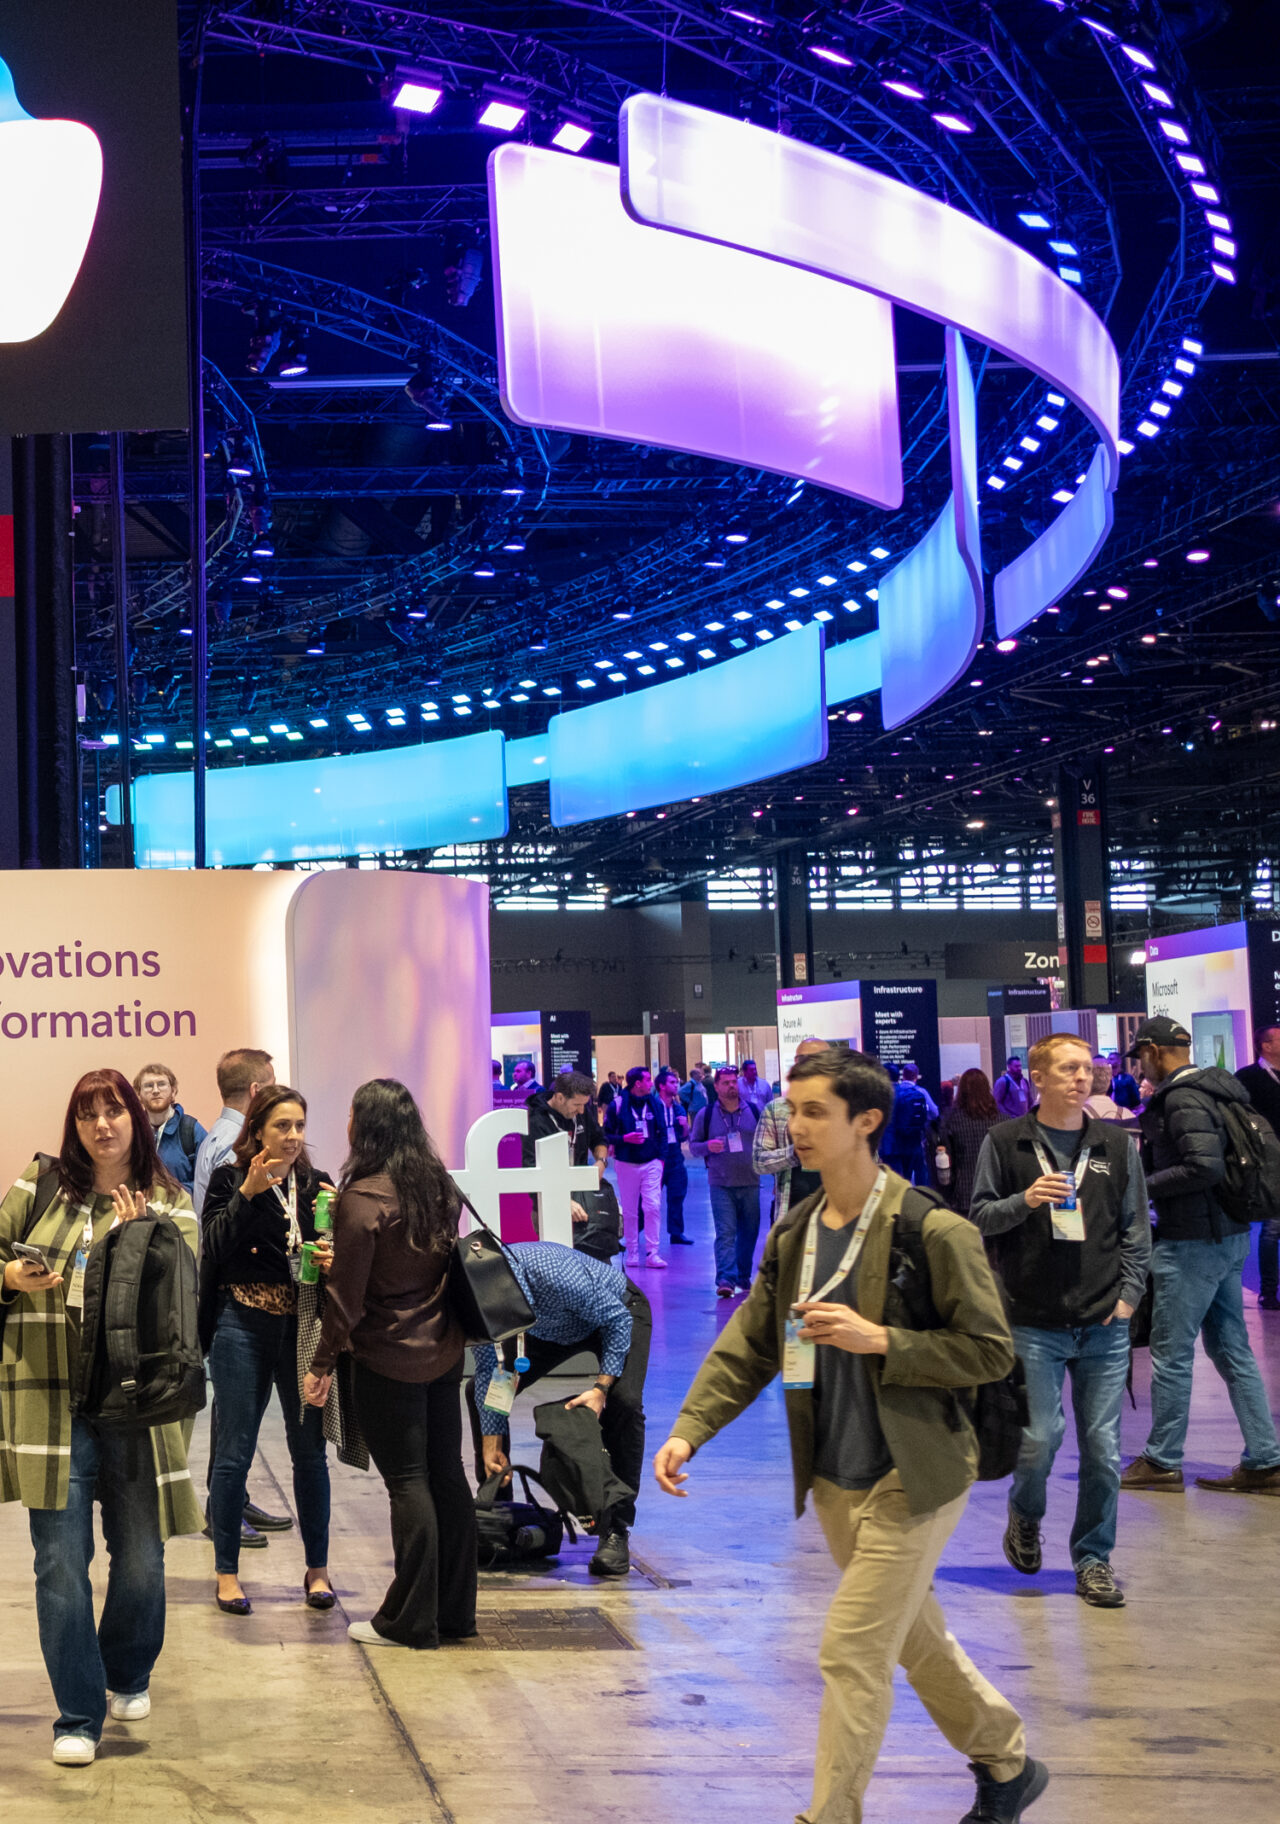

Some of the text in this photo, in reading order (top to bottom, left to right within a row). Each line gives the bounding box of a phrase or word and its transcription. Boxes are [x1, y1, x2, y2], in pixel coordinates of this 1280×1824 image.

[1081, 793, 1096, 804] 36
[1024, 952, 1060, 968] Zon
[874, 986, 923, 994] Infrastructure
[1152, 979, 1178, 996] Microsoft
[783, 1018, 796, 1028] Azure
